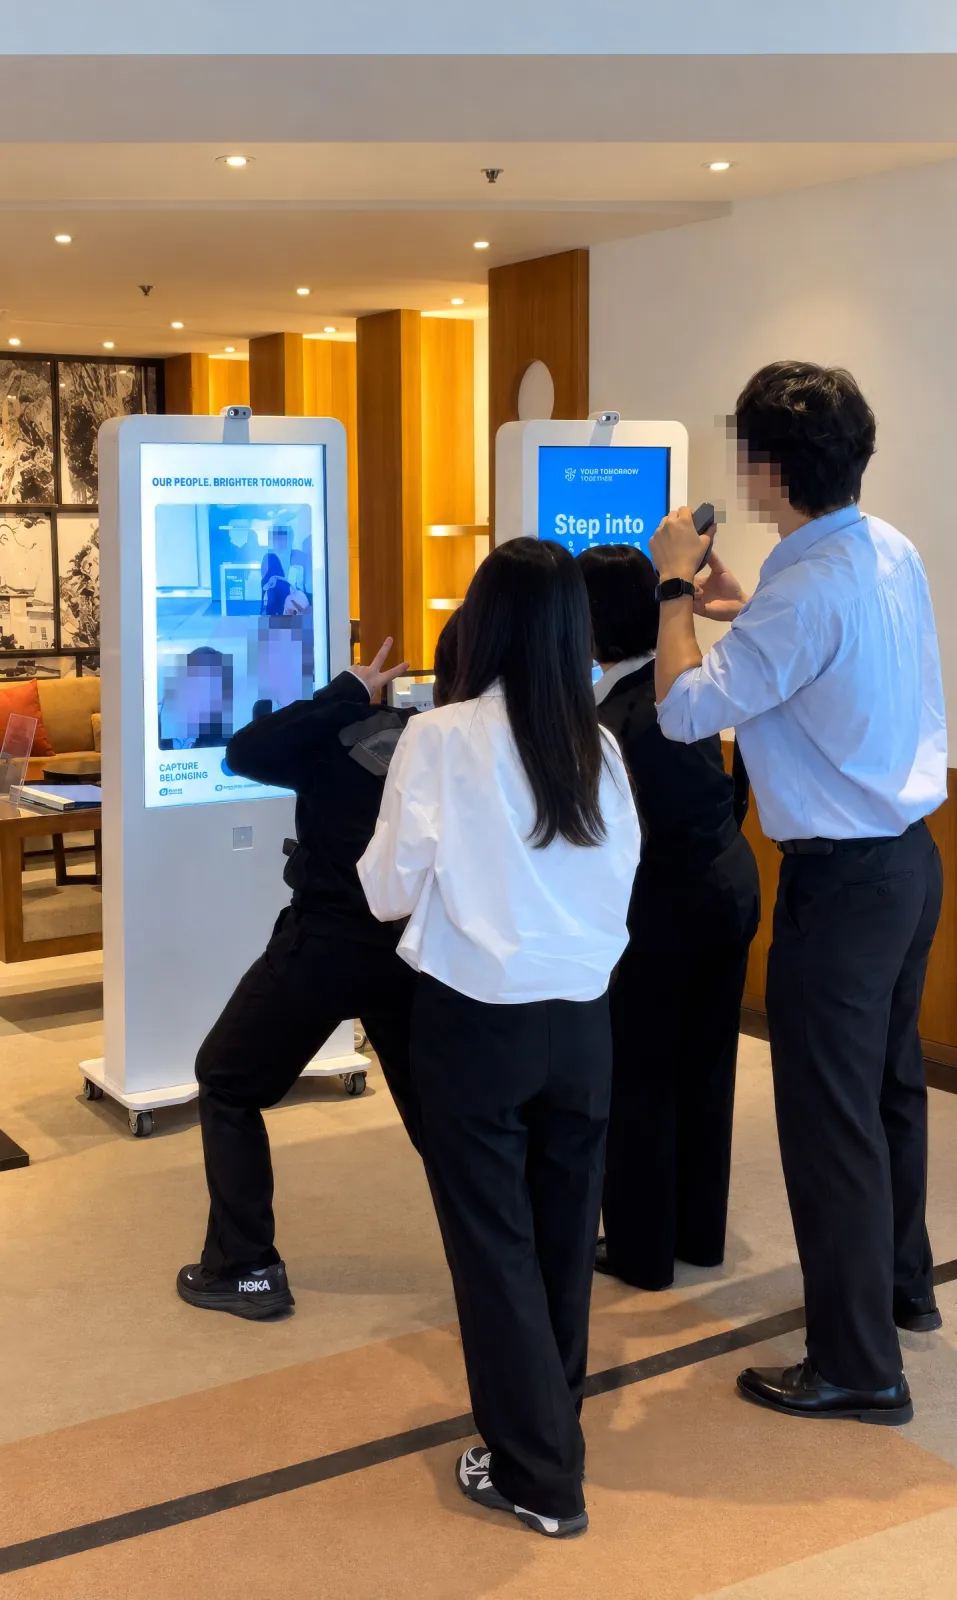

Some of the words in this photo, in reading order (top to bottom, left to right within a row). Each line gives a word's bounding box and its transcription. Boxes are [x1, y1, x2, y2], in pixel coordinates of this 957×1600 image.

[152, 477, 172, 487] OUR
[174, 477, 212, 487] PEOPLE.
[213, 477, 259, 487] BRIGHTER
[260, 477, 314, 487] TOMORROW.
[554, 513, 600, 539] Step
[605, 513, 644, 535] into
[159, 761, 199, 772] CAPTURE
[159, 771, 209, 782] BELONGING
[238, 1280, 271, 1292] HOKA
